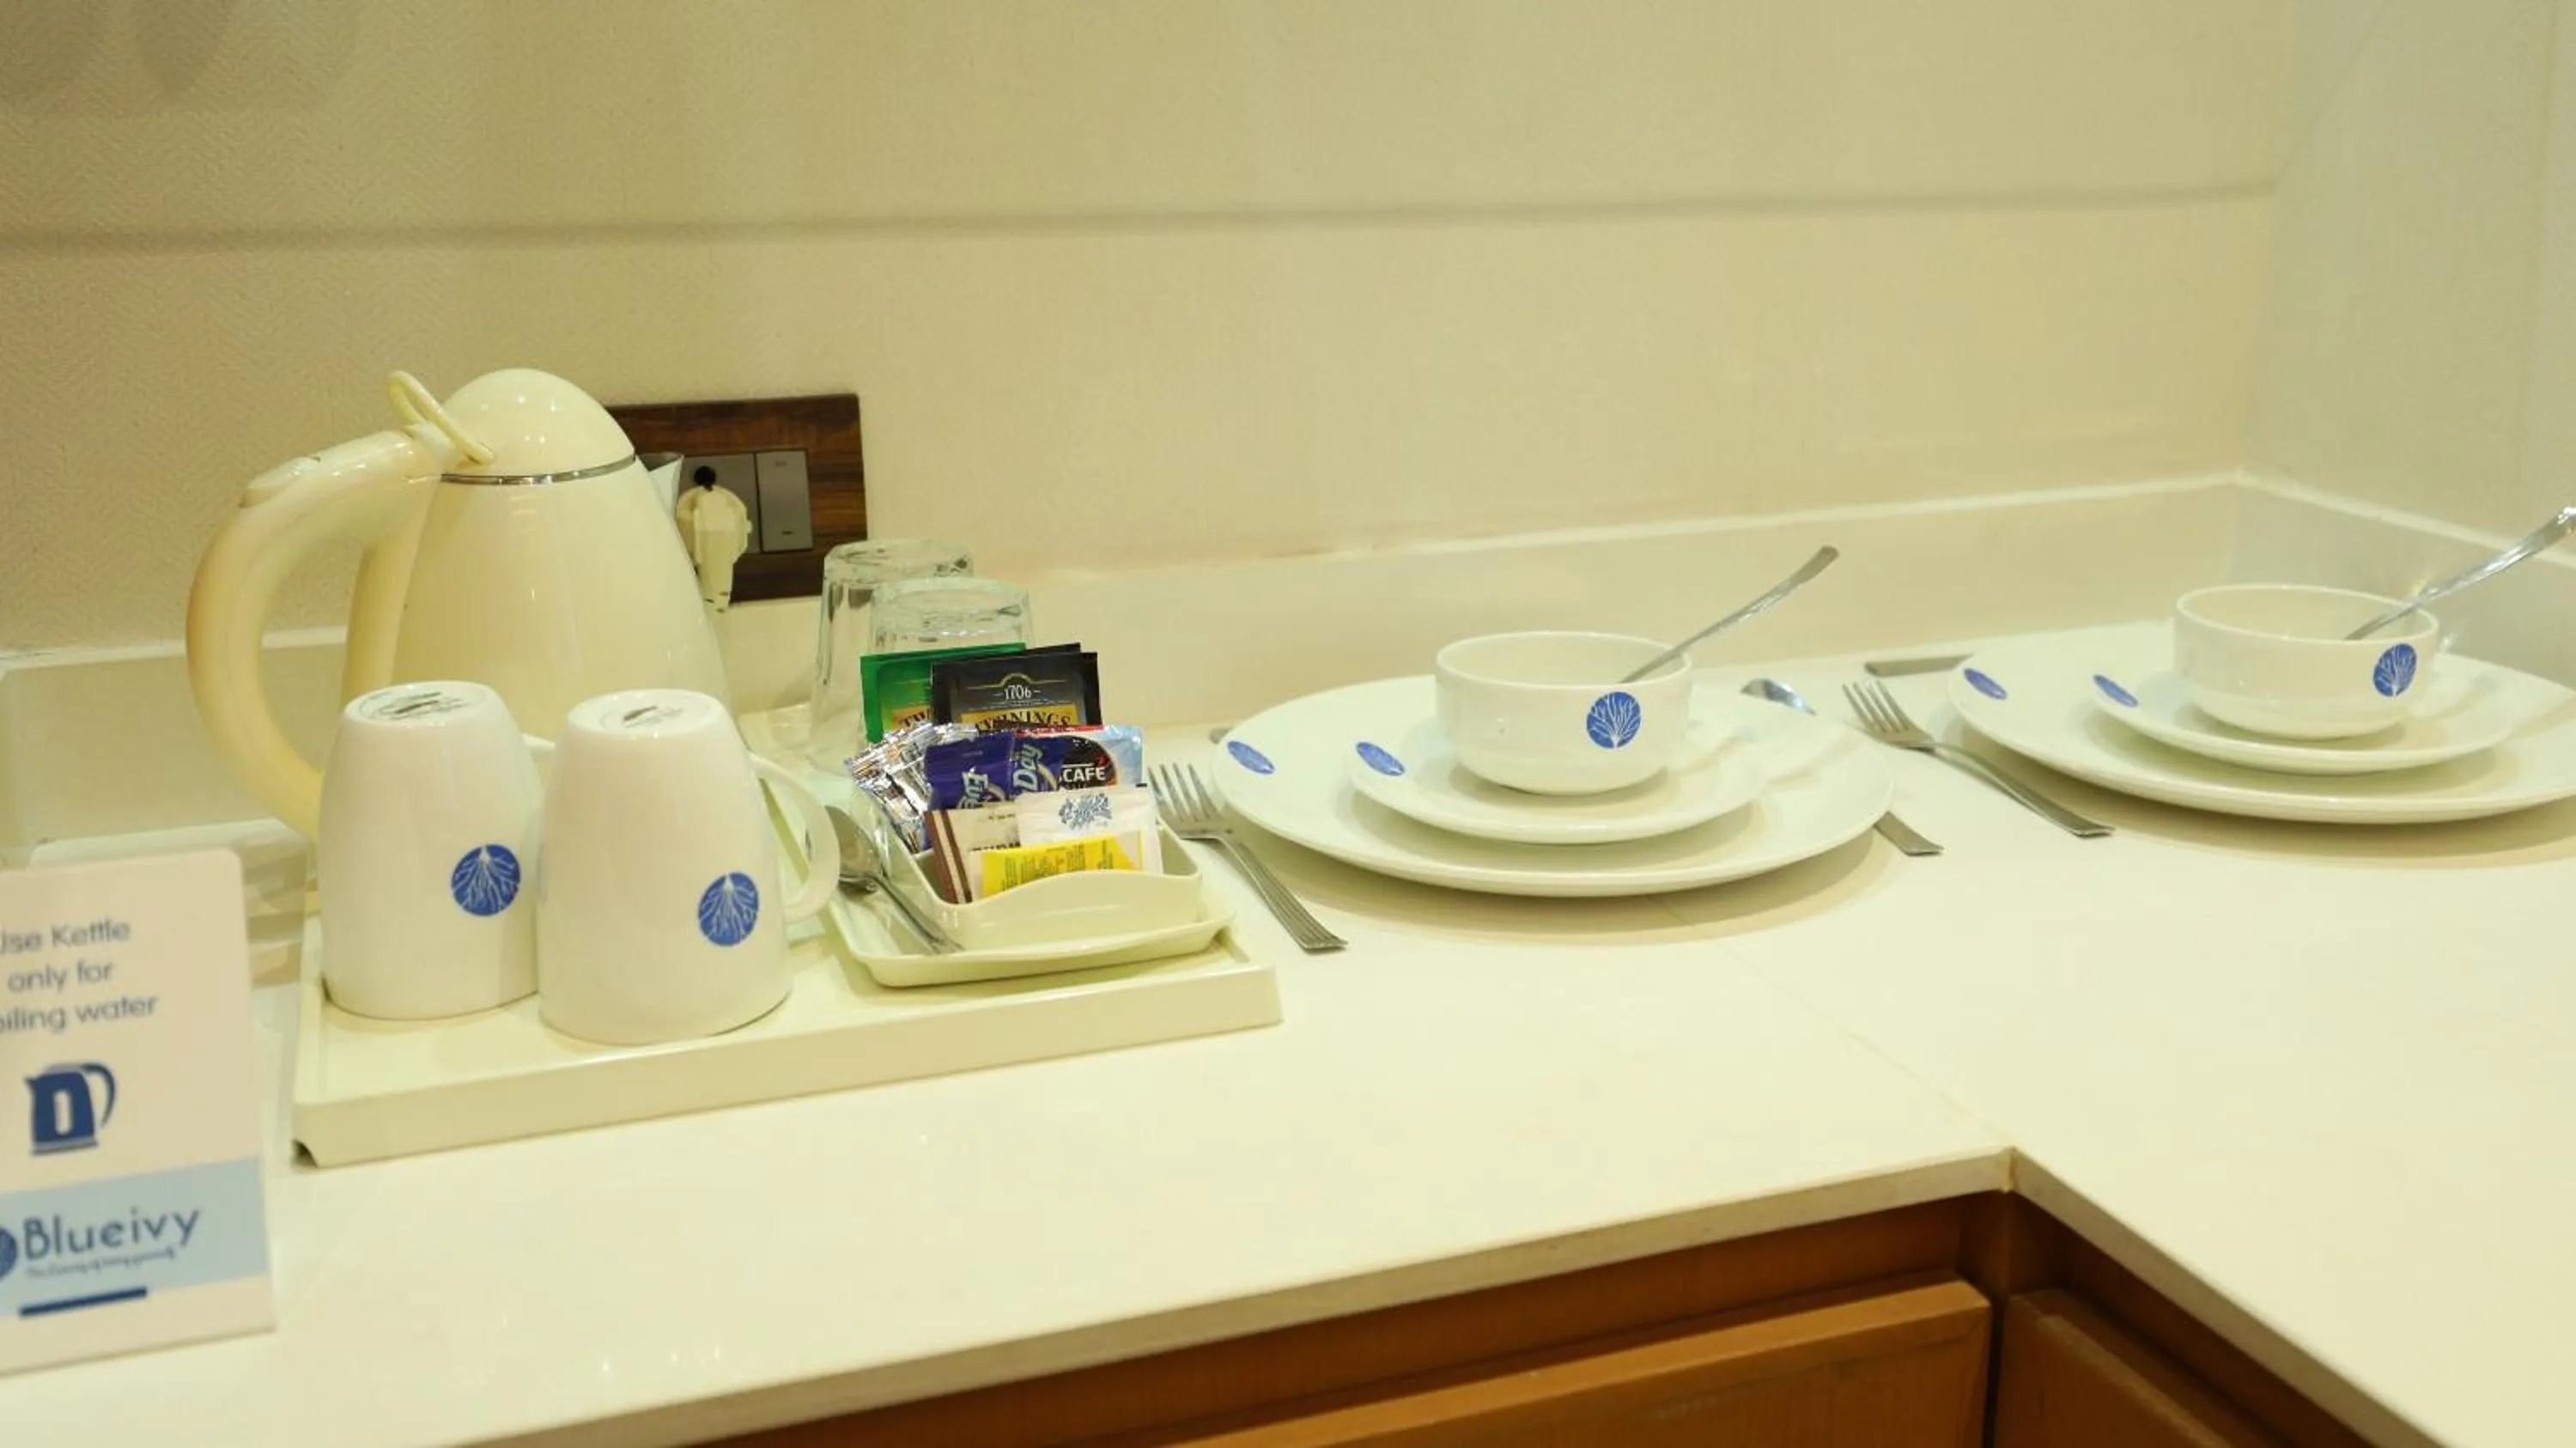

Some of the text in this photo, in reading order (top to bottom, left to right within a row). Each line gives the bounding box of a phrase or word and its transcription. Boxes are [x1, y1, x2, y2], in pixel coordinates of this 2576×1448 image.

[1004, 684, 1032, 700] 1706
[51, 919, 131, 948] Kettle
[8, 958, 115, 995] only for
[74, 995, 160, 1025] water
[24, 1207, 201, 1260] Blueivy
